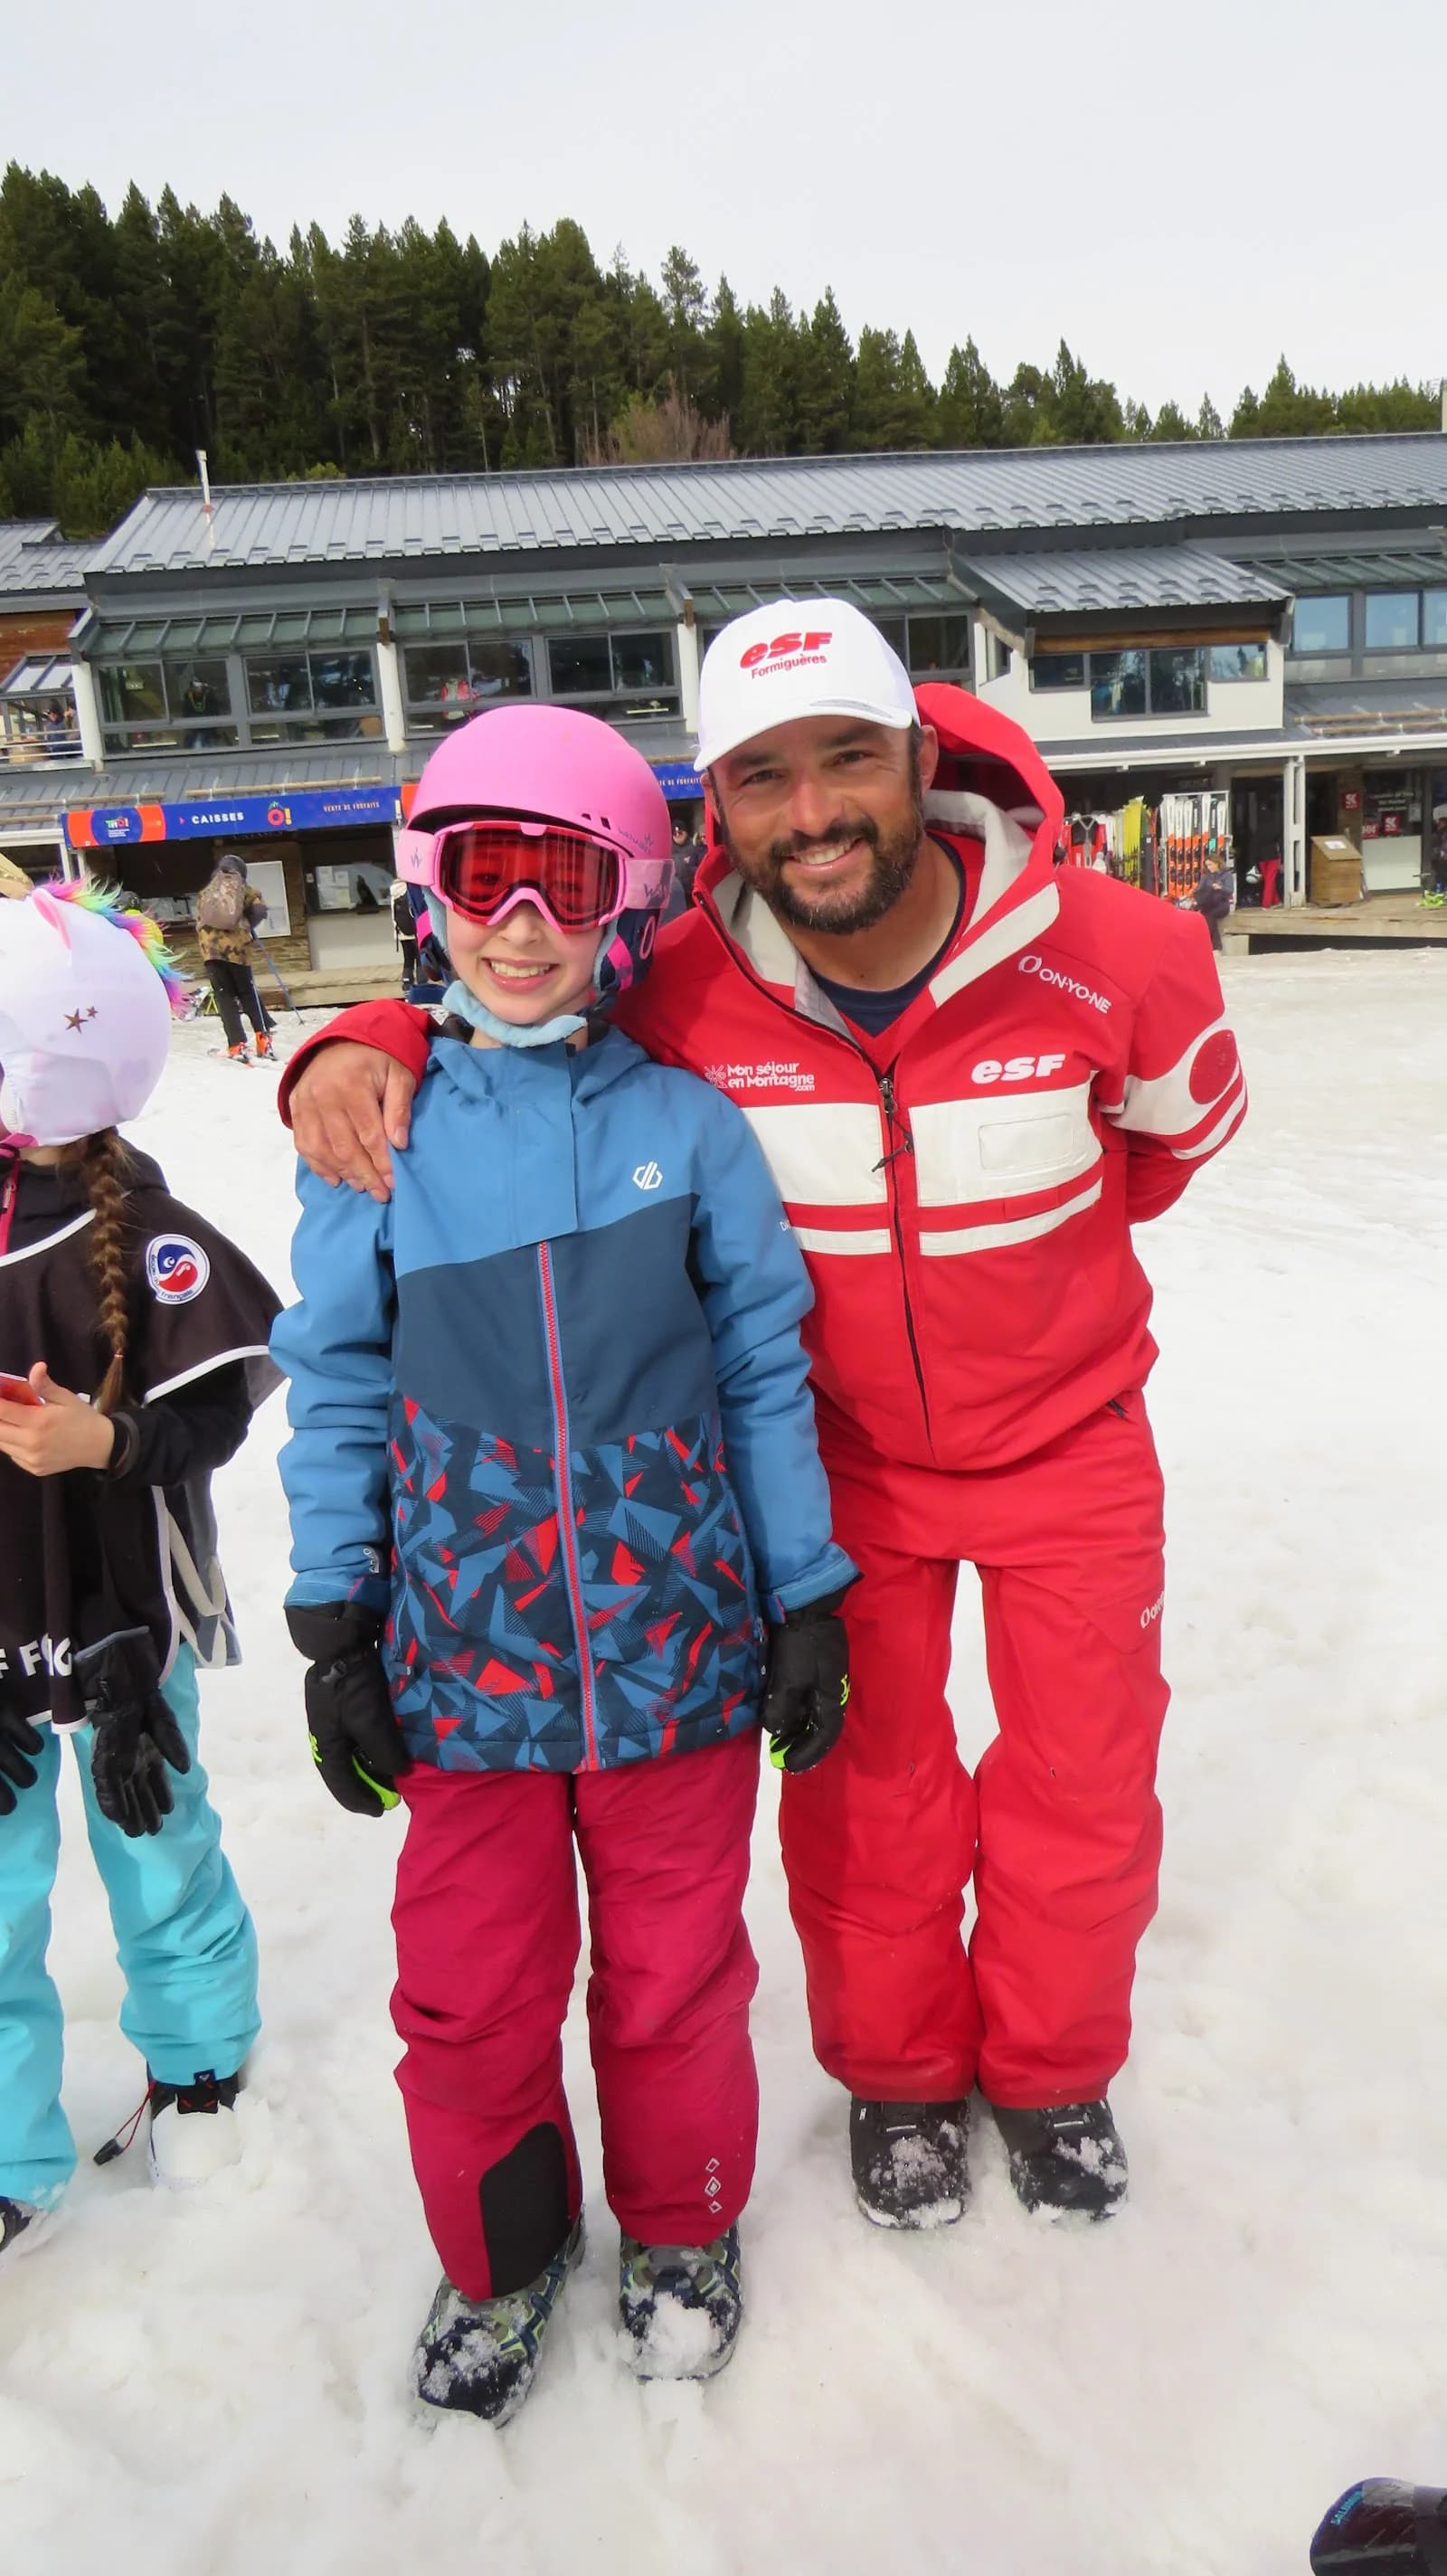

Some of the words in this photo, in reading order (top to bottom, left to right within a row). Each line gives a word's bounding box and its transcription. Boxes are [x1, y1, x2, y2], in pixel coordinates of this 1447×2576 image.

[752, 653, 827, 678] Formiguères
[191, 812, 244, 824] CAISSES
[727, 1064, 752, 1076] Mon
[756, 1061, 799, 1078] séjour
[727, 1077, 744, 1088] en
[746, 1074, 814, 1088] Montagne
